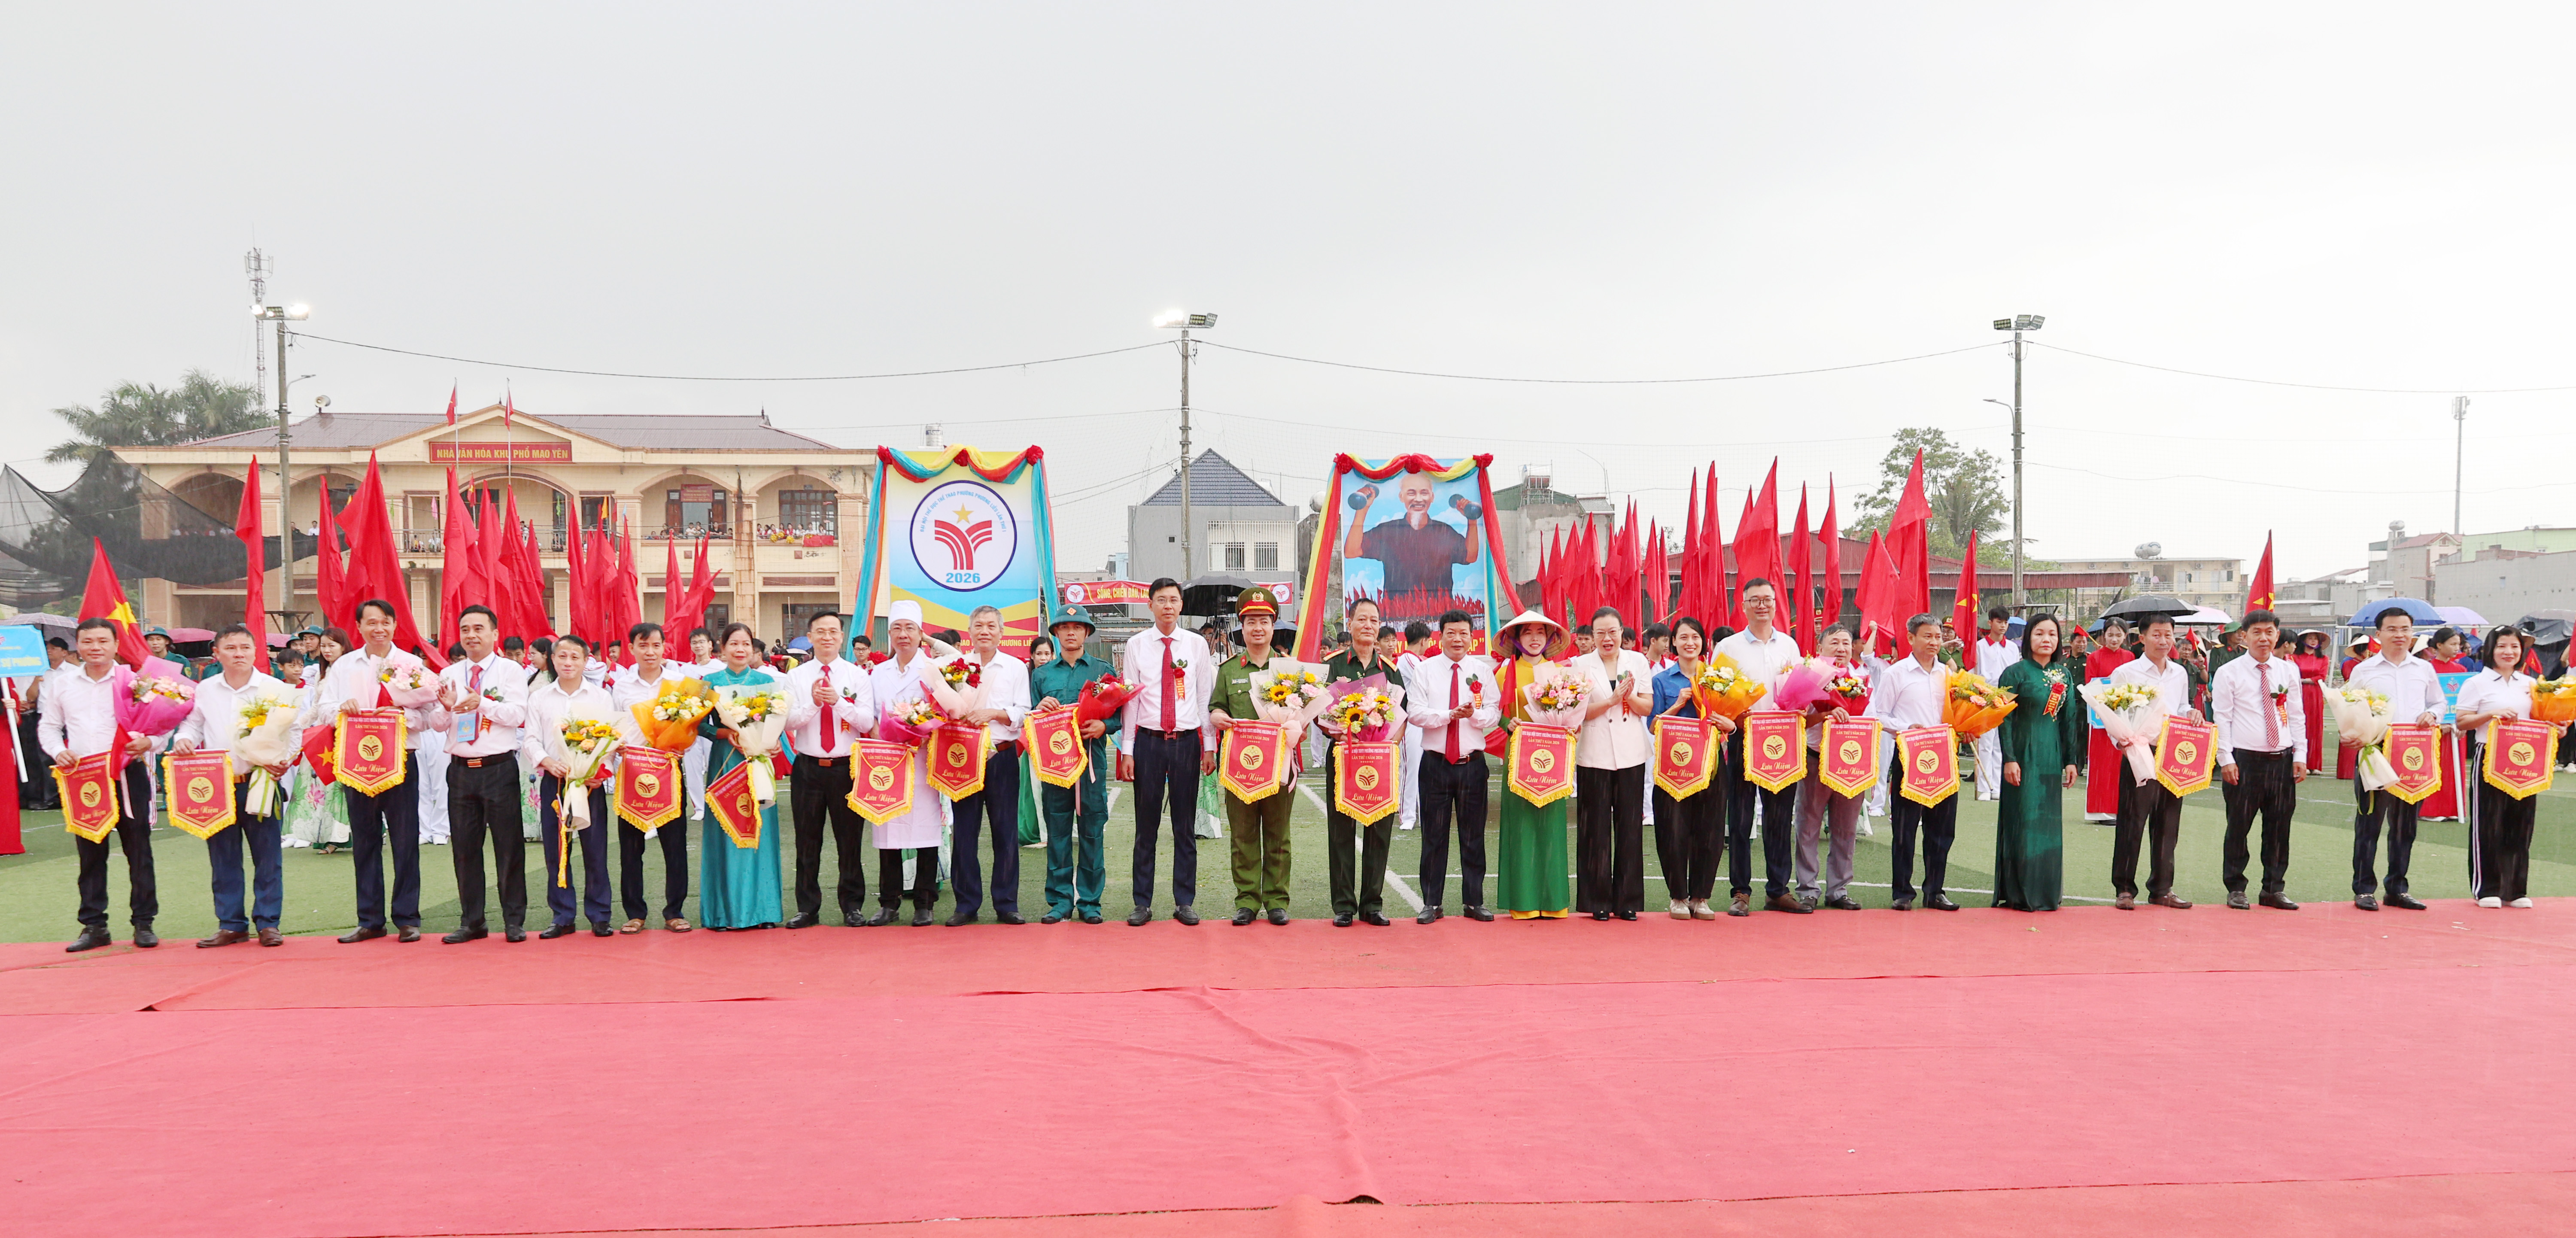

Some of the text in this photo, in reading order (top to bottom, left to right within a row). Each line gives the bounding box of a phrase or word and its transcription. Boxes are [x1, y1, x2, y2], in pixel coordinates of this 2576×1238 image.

[437, 447, 455, 458] NHÀ
[532, 450, 550, 458] MAO
[552, 448, 568, 458] YÊN
[946, 572, 980, 583] 2026
[1097, 585, 1112, 599] SỐNG,
[1113, 584, 1127, 598] CHIẾN
[1366, 793, 1382, 802] Niệm
